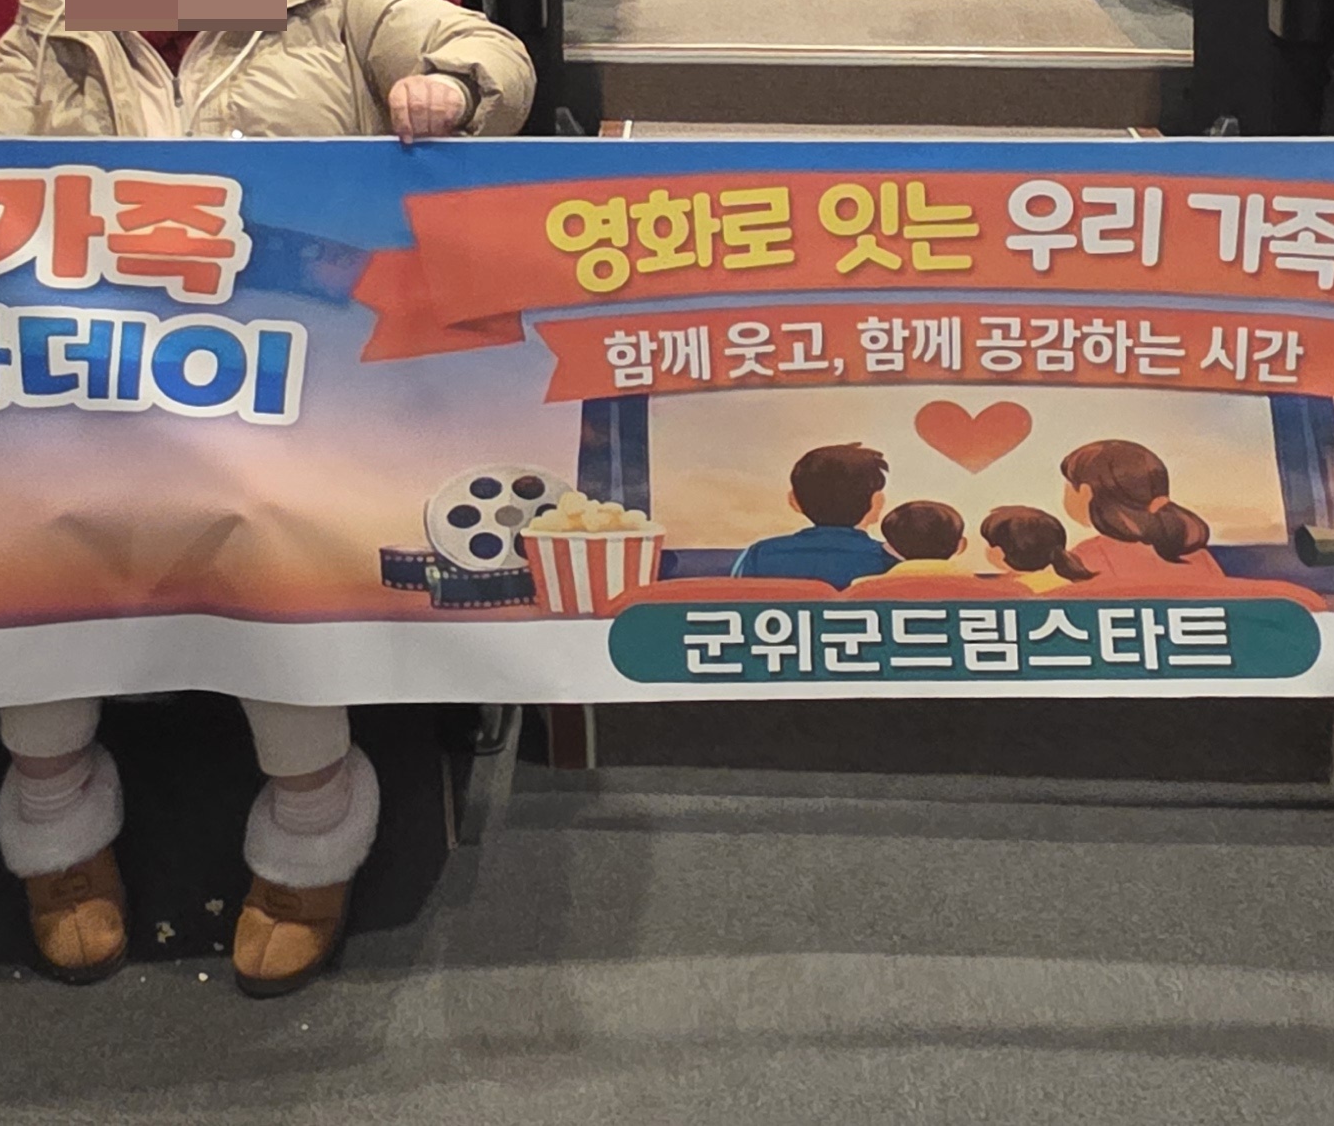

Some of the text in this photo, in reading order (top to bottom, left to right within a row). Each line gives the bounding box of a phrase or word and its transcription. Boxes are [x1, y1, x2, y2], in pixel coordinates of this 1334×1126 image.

[545, 186, 796, 294] 영화로
[817, 180, 980, 274] 잇는
[1005, 178, 1163, 272] 우리
[603, 314, 1305, 389] 함께 웃고, 함께 공감하는 시간
[683, 606, 1231, 673] 군위군드림스타트
